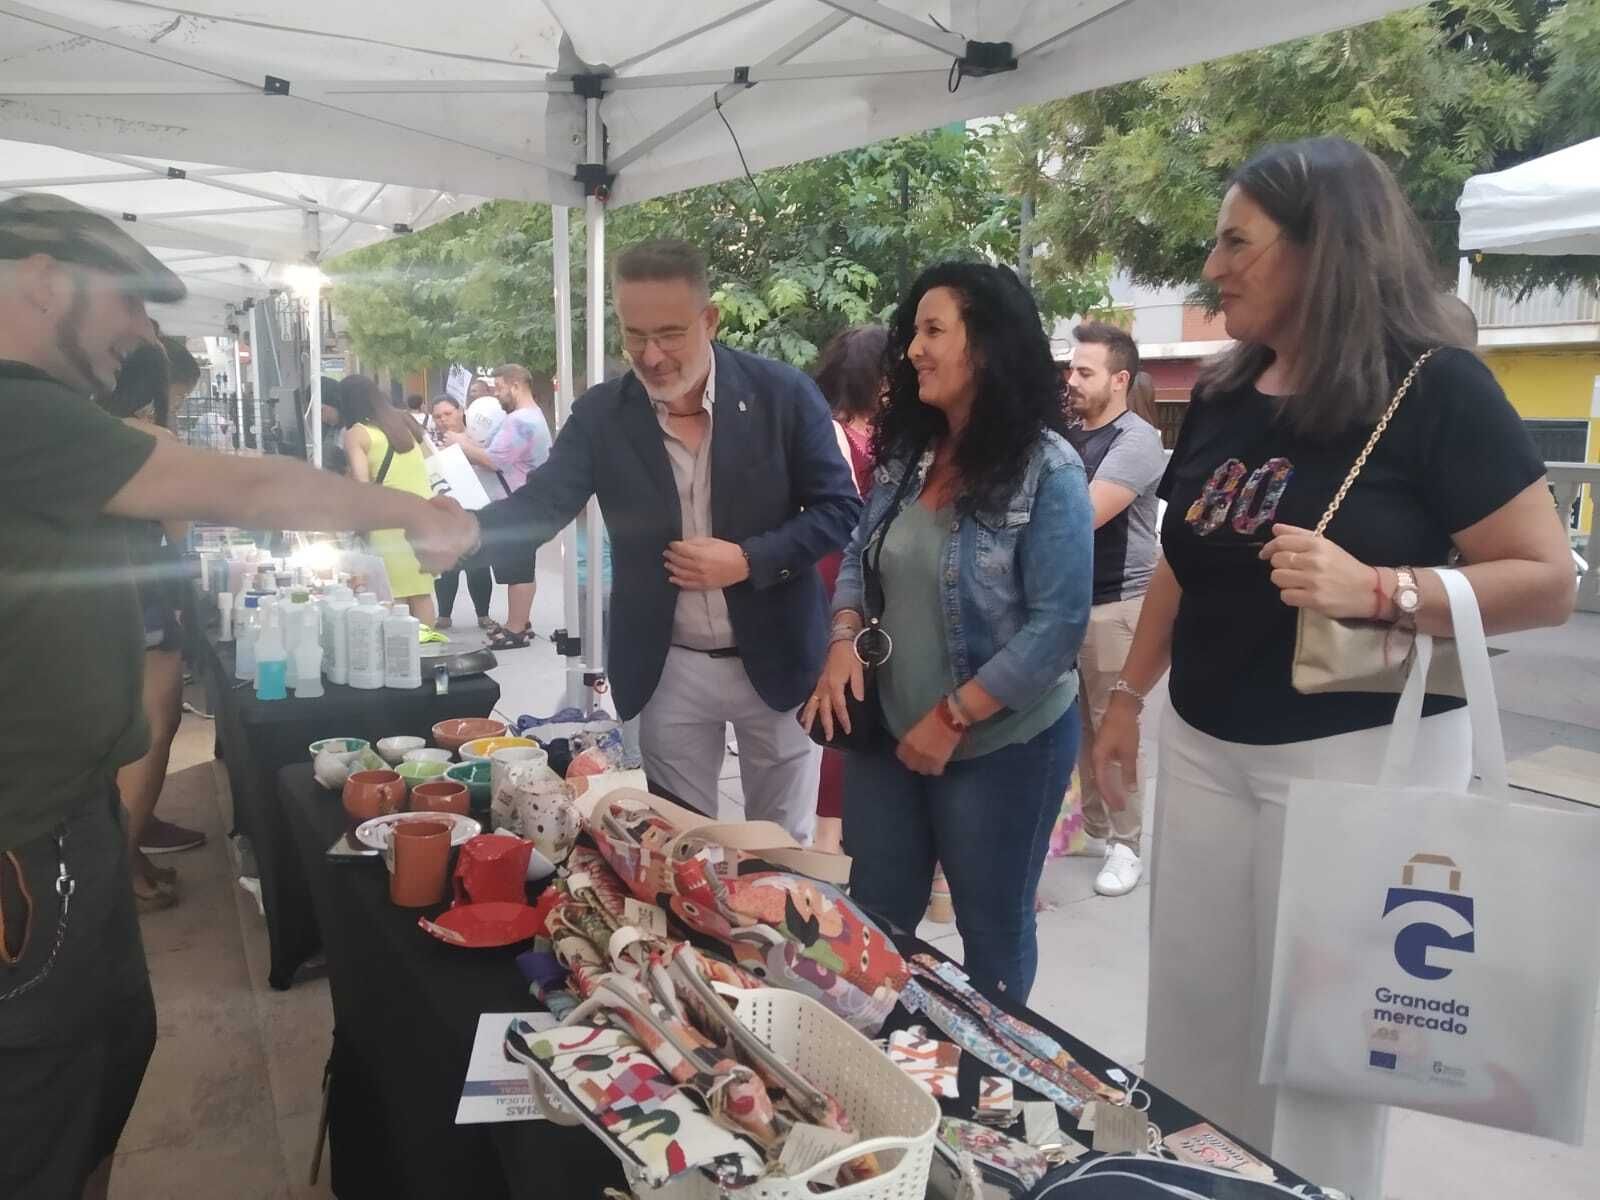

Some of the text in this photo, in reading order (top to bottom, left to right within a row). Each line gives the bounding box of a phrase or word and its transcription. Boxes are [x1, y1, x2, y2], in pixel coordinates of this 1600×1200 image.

[1184, 457, 1294, 536] 80
[1375, 987, 1470, 1017] Granada
[1373, 1008, 1468, 1035] mercado
